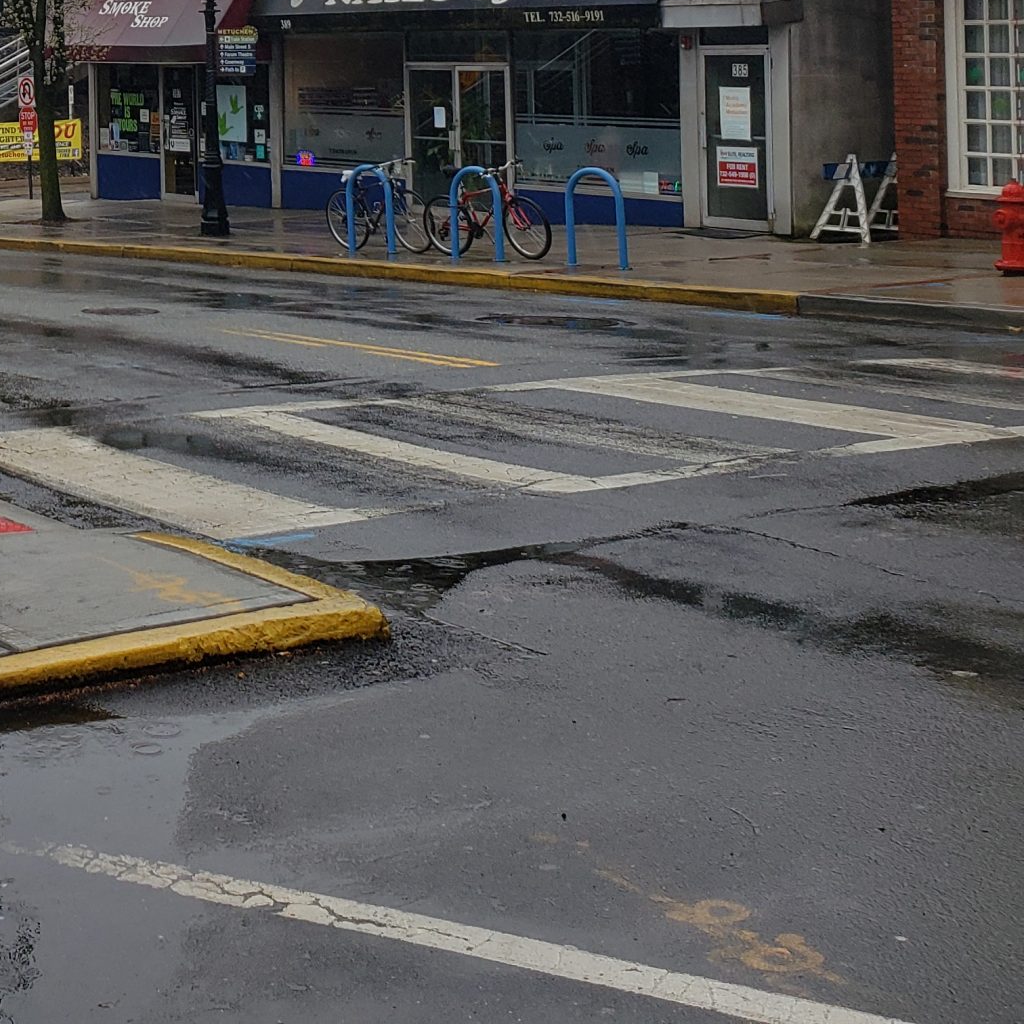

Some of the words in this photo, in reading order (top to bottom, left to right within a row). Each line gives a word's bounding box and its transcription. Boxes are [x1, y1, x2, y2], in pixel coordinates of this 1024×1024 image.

[523, 11, 545, 23] TEL.
[549, 9, 605, 23] 732-516-9191
[733, 64, 748, 76] 385
[123, 92, 145, 106] WORLD
[21, 111, 35, 120] STOP
[124, 106, 131, 118] IS
